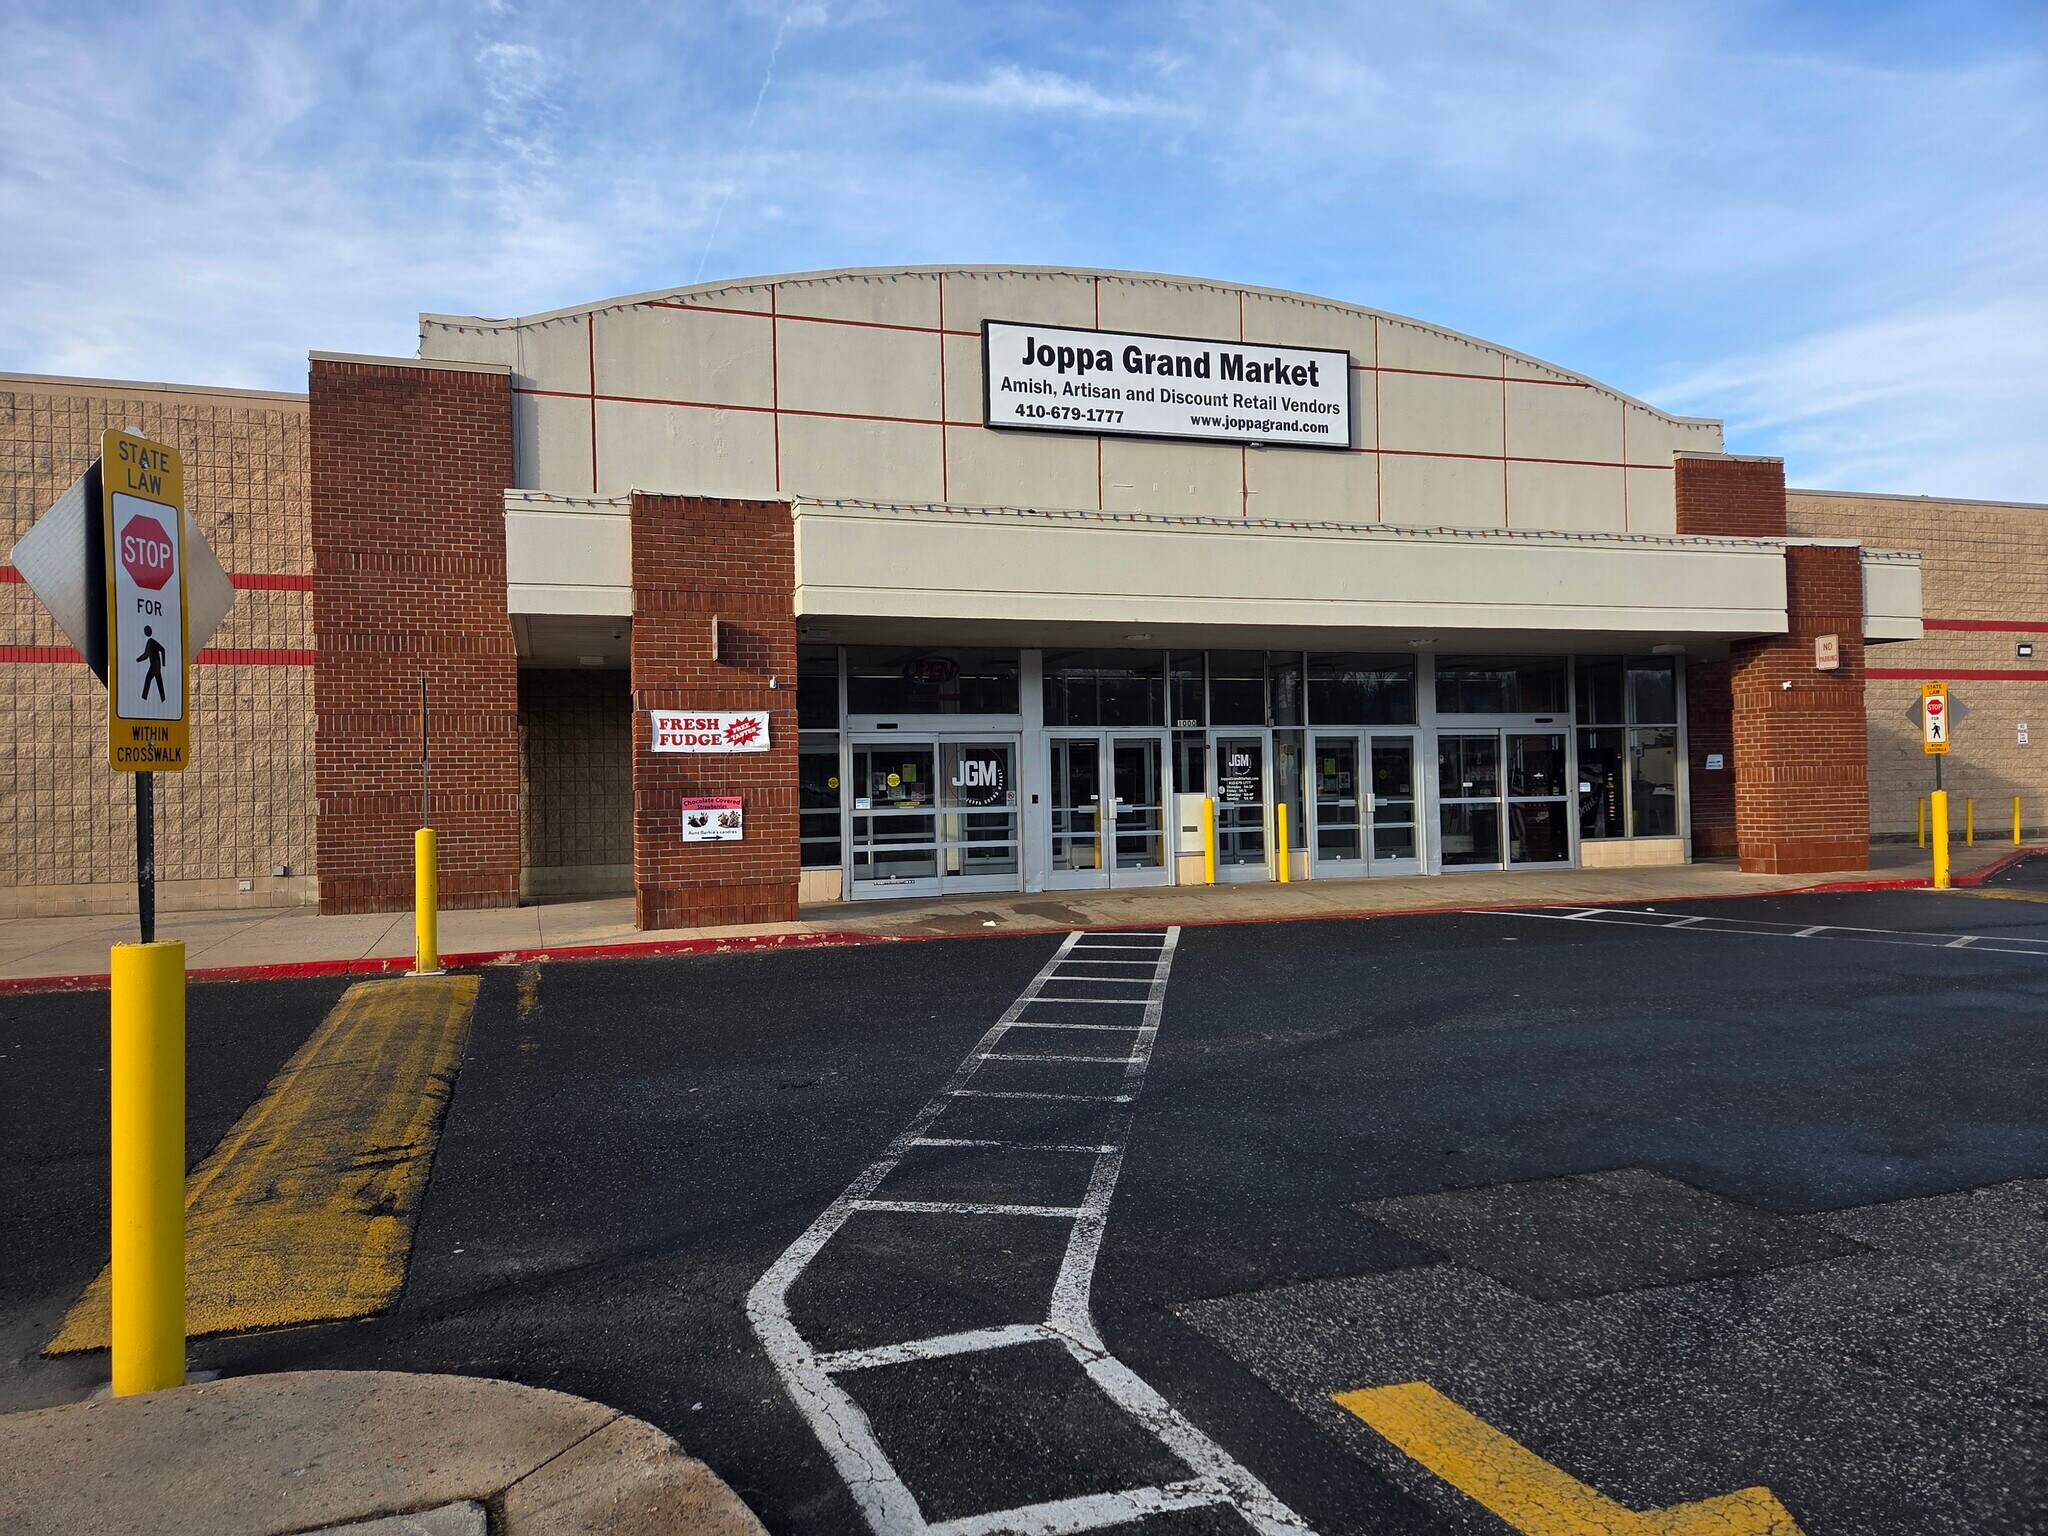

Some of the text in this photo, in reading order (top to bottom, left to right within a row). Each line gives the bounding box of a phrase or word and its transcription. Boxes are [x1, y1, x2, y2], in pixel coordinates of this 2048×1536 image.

[1022, 336, 1320, 387] Joppa Grand Market
[1001, 376, 1341, 415] Amish, Artisan and Discount Retail Vendors
[1015, 403, 1124, 424] 410-679-1777
[1190, 415, 1329, 434] www.joppagrand.com
[118, 440, 170, 474] STATE
[127, 468, 162, 496] LAW
[124, 536, 171, 569] STOP
[137, 598, 163, 617] FOR
[1823, 641, 1833, 651] NO
[1927, 703, 1943, 711] STOP
[132, 725, 169, 742] WITHIN
[658, 718, 720, 730] FRESH
[659, 733, 723, 746] FUDGE
[117, 746, 182, 763] CROSSWALK
[1228, 754, 1249, 767] JGM
[952, 760, 997, 786] JGM
[683, 797, 741, 806] Chocolate Covered
